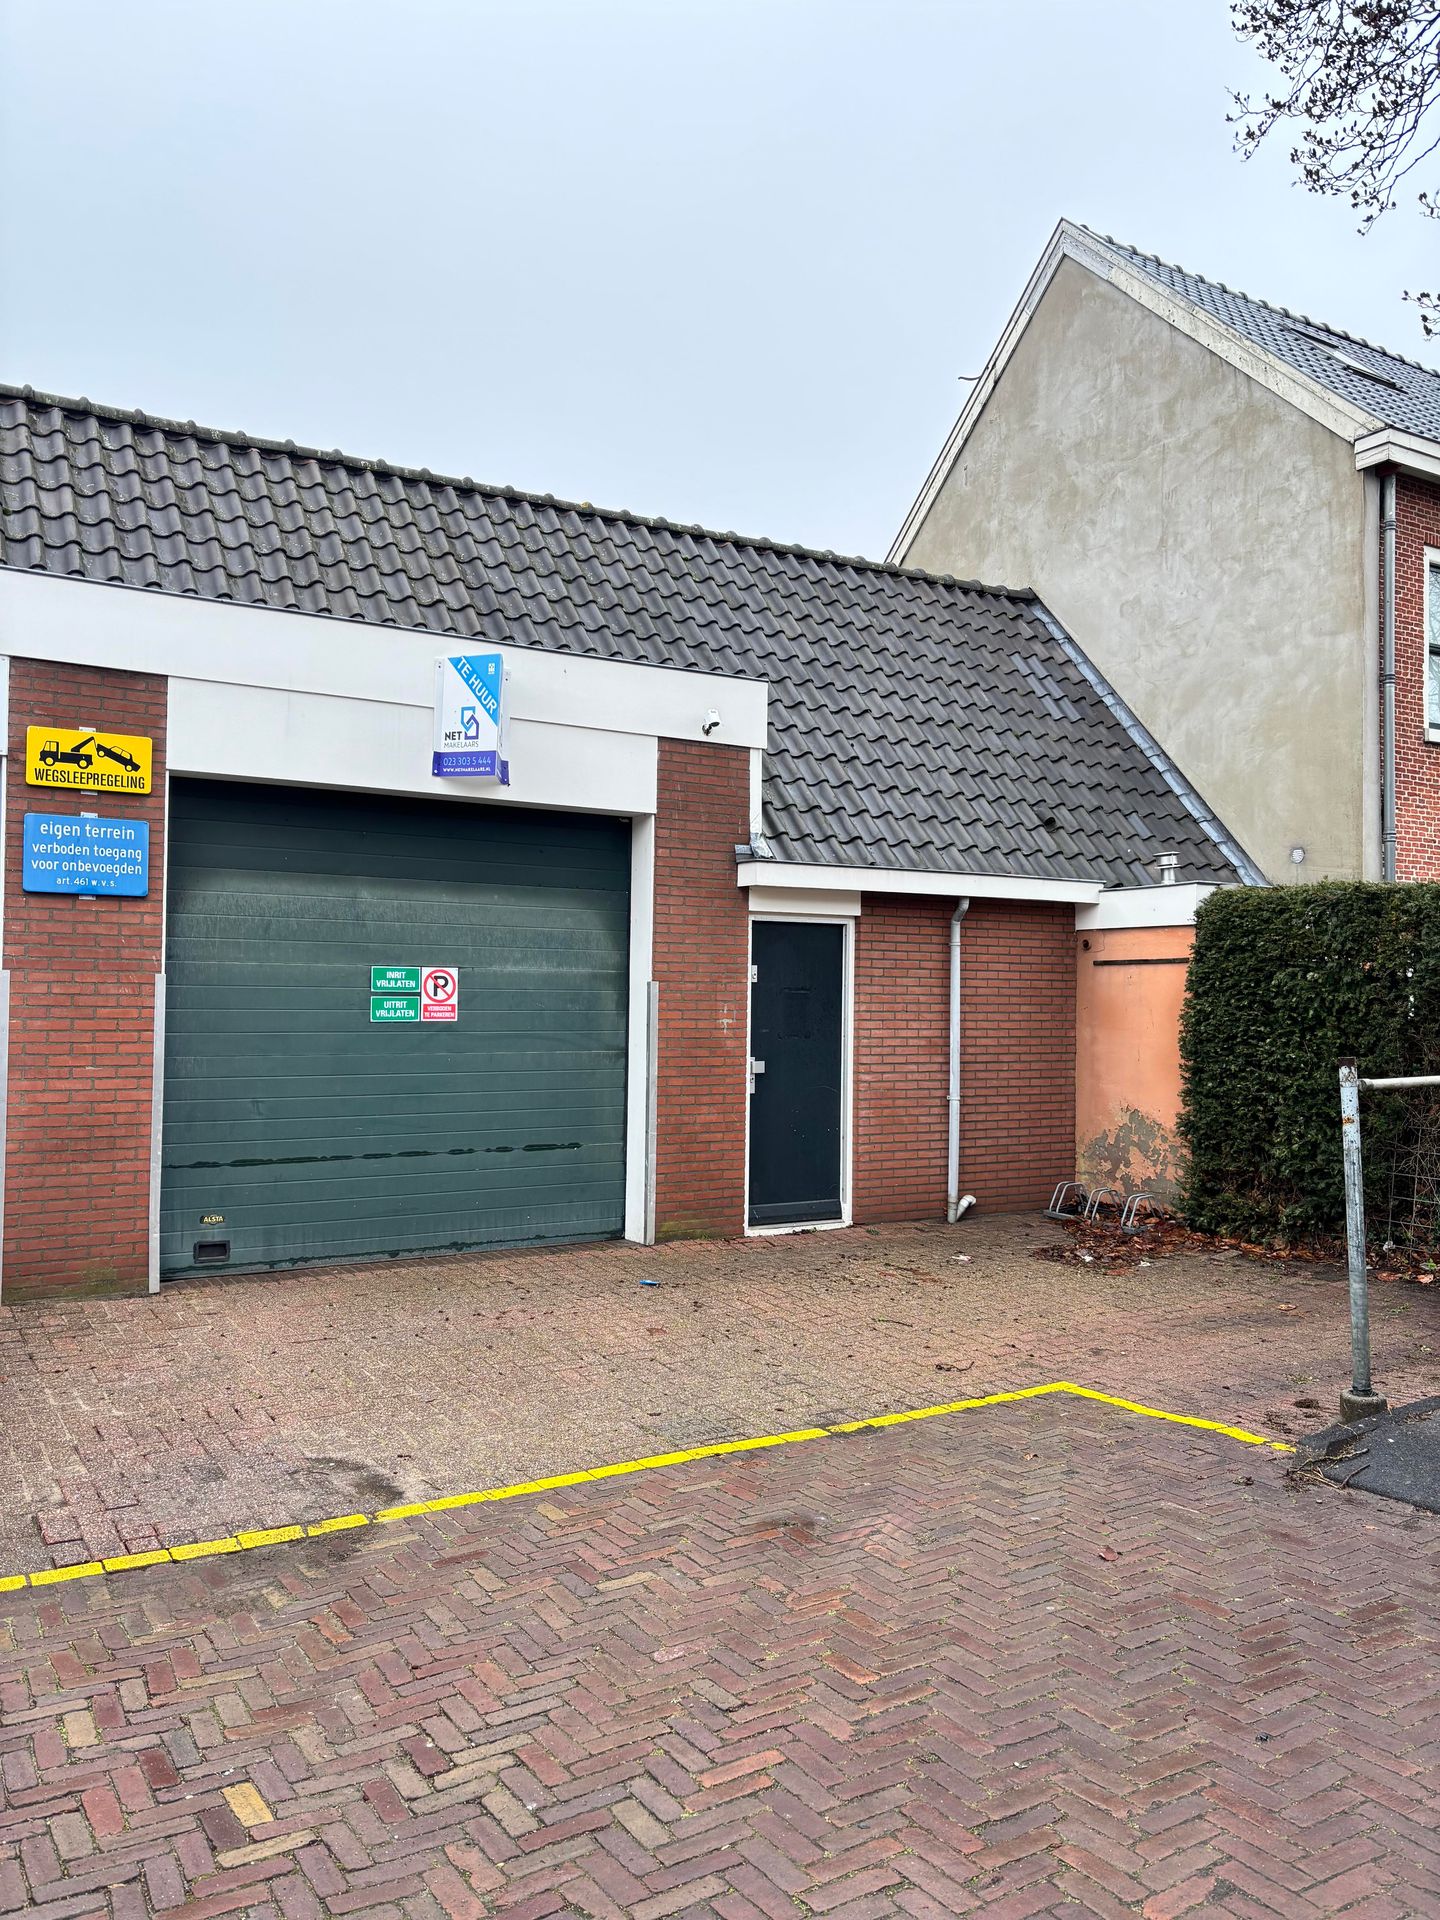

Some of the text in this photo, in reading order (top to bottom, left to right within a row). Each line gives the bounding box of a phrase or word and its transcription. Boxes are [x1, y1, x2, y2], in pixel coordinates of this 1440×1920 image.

[457, 656, 497, 715] TE HUUR
[444, 731, 462, 741] NET
[443, 756, 491, 766] 023 303 5 444
[34, 767, 145, 789] WEGSLEEPREGELING
[40, 821, 135, 840] eigen terrein
[32, 842, 142, 862] verboden toegang
[31, 859, 142, 877] voor onbevoegden
[91, 879, 117, 888] w.v.s.
[386, 971, 406, 979] INRIT
[376, 980, 416, 988] VRIJLATEN
[383, 1001, 407, 1009] UITRIT
[375, 1009, 415, 1017] VRIJLATEN
[203, 1215, 224, 1223] ALSTA
